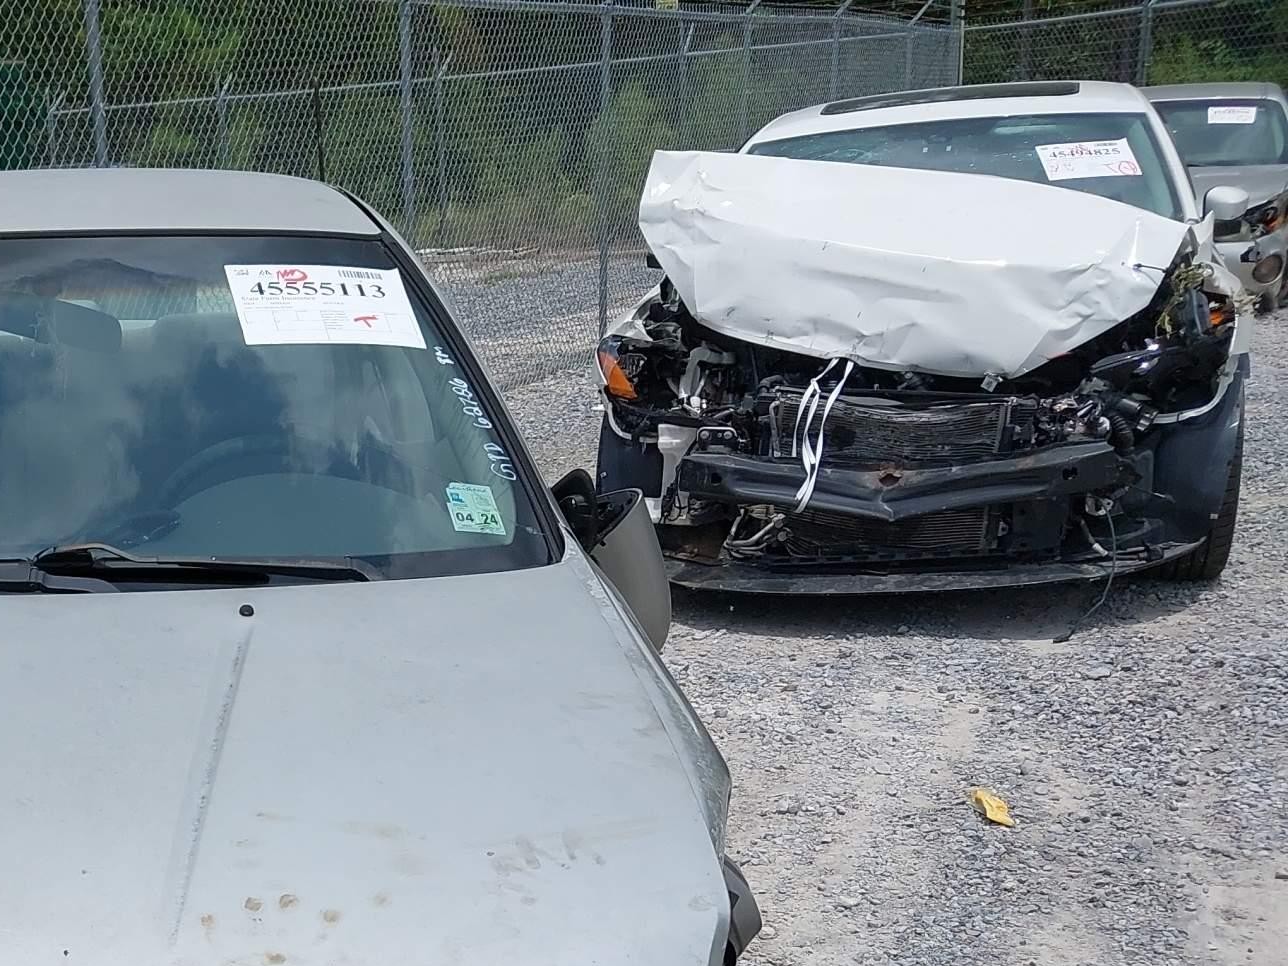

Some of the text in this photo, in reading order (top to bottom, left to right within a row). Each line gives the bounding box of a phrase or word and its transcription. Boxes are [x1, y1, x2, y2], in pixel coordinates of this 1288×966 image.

[249, 281, 386, 299] 45555113
[455, 511, 498, 525] 04 24
